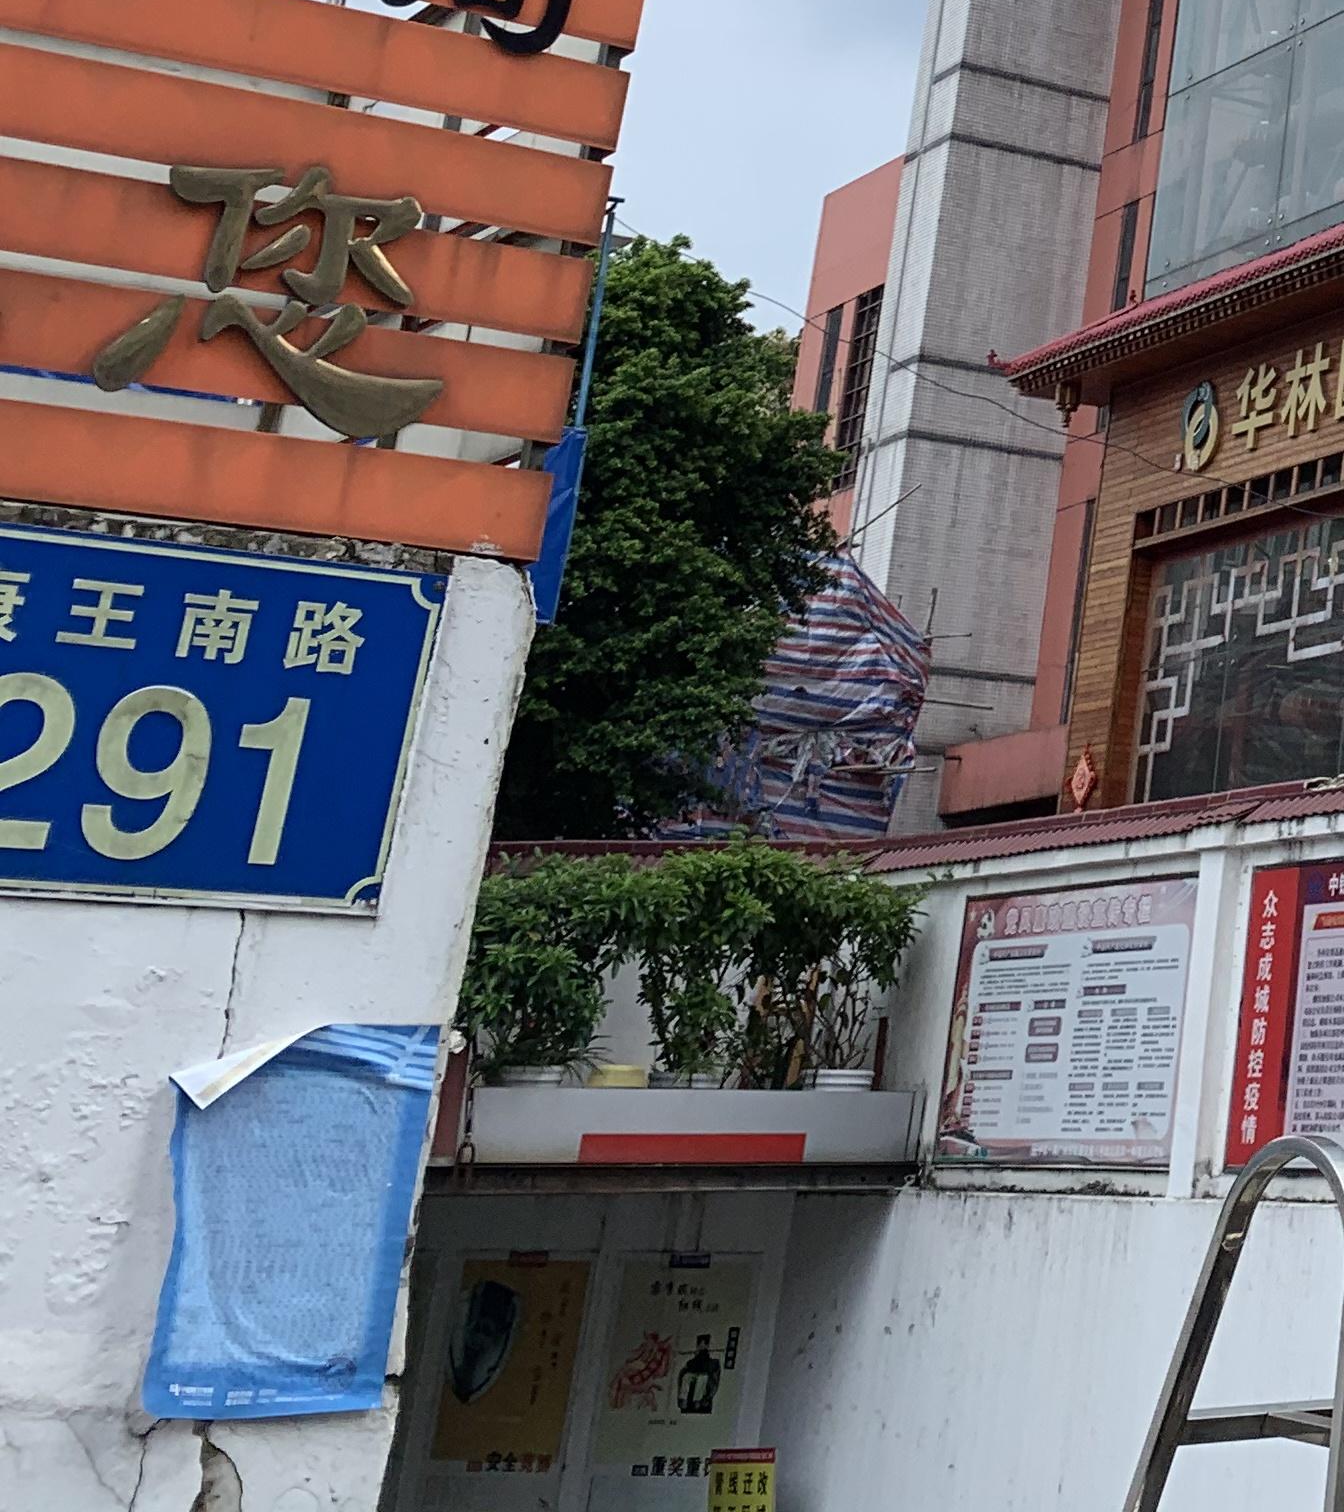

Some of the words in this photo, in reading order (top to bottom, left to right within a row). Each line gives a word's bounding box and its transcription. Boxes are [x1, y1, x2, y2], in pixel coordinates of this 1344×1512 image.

[91, 164, 444, 439] 您
[0, 672, 311, 866] 291
[1240, 890, 1280, 1145] 众志成城防控疫情
